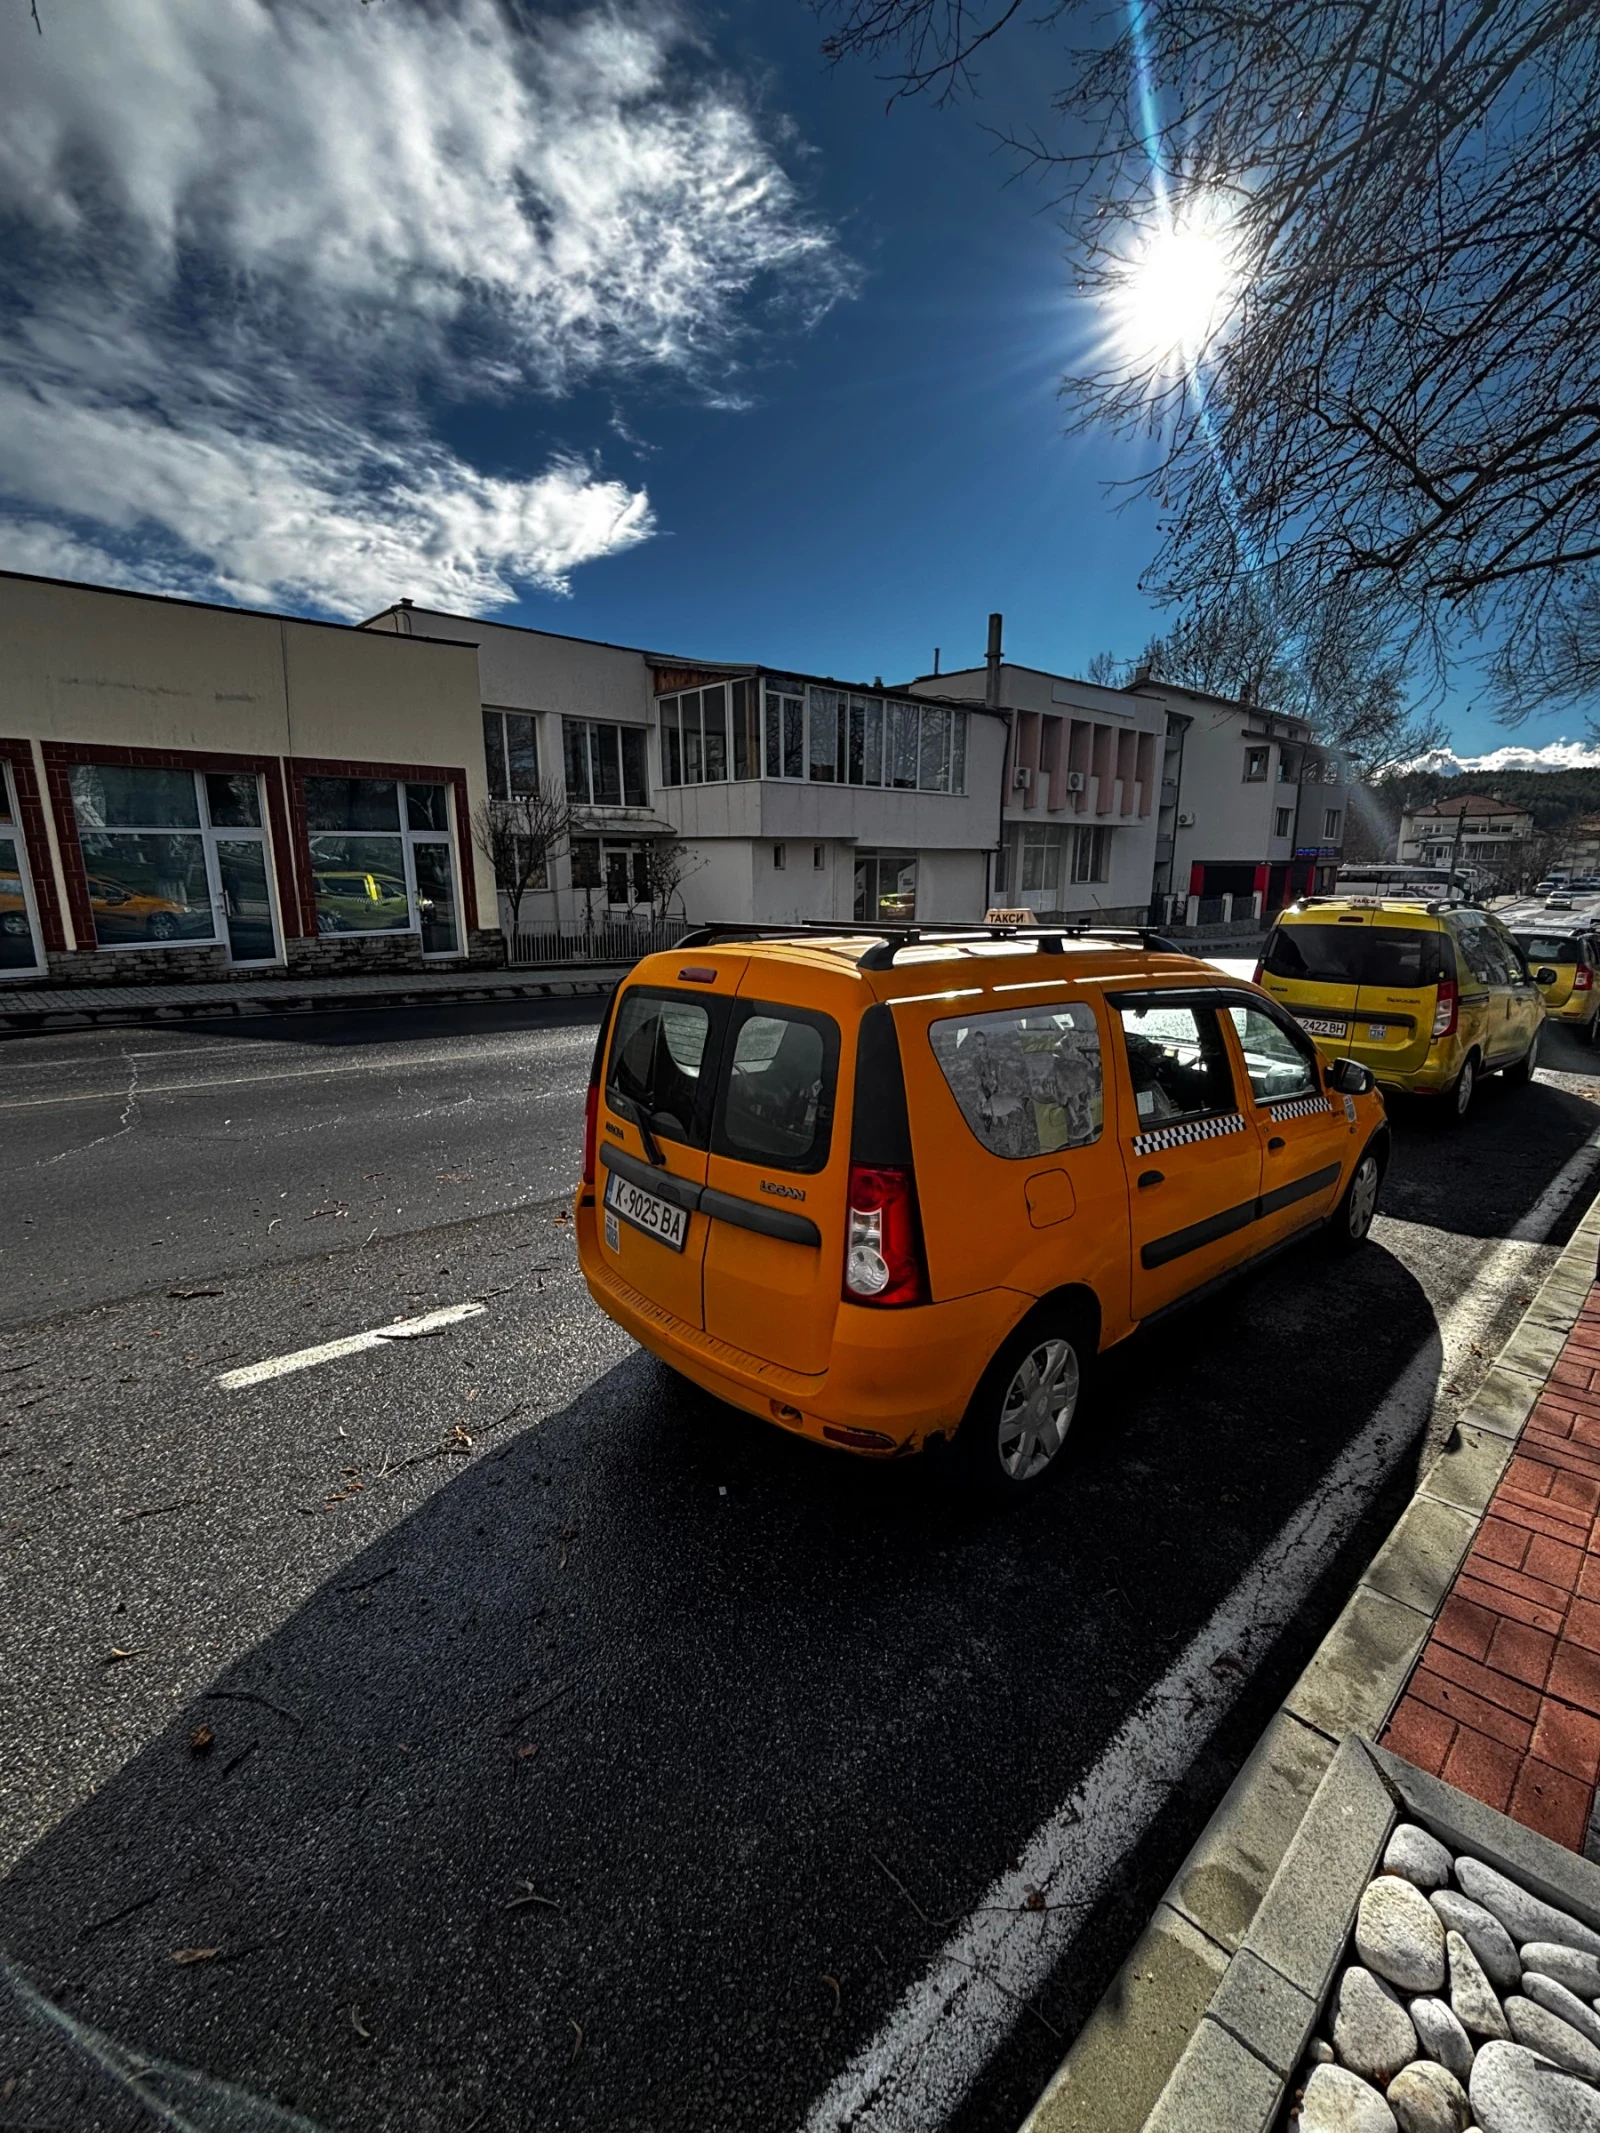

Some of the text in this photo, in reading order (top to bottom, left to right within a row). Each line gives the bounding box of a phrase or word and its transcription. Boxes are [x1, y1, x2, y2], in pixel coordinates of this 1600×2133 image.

[989, 912, 1024, 924] ТАКСИ
[1302, 1019, 1328, 1032] 2422
[1328, 1023, 1345, 1035] BH
[760, 1179, 806, 1202] LOGAN
[660, 1206, 681, 1242] BA
